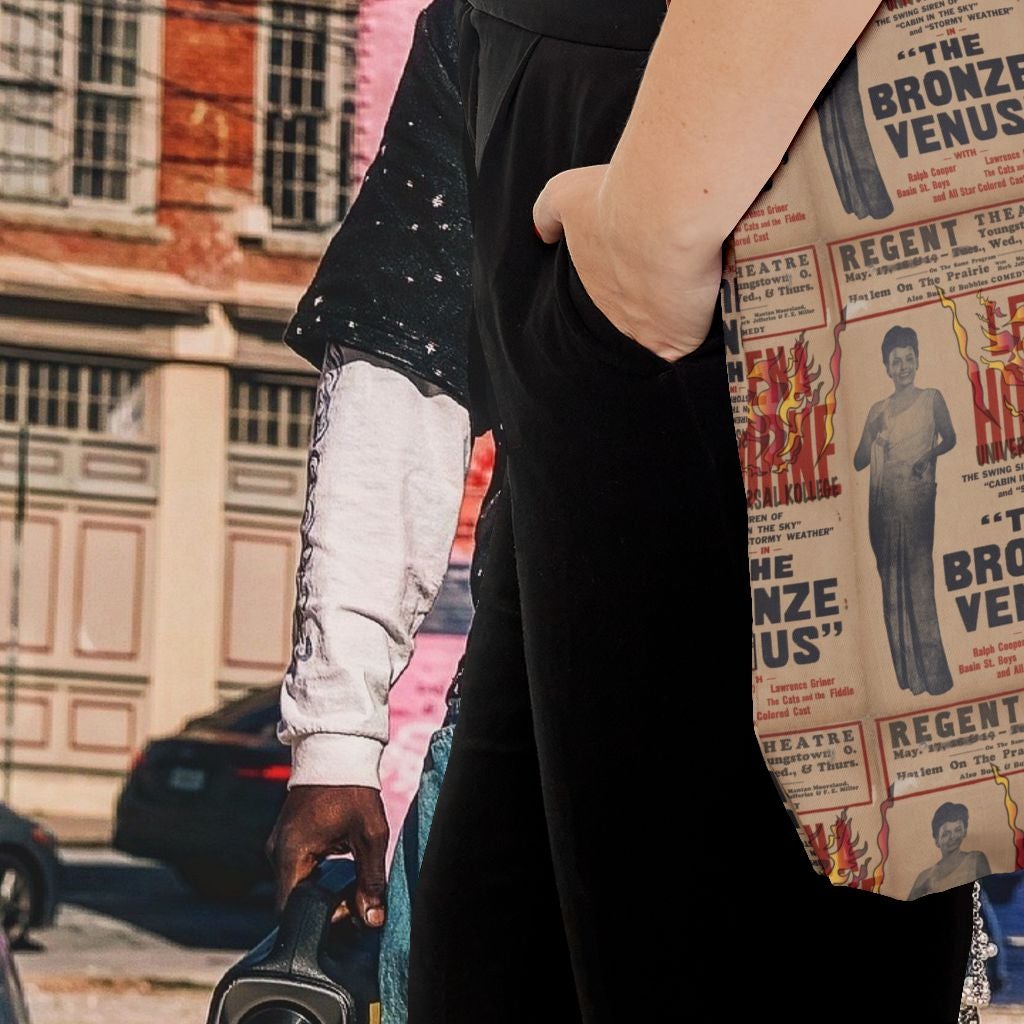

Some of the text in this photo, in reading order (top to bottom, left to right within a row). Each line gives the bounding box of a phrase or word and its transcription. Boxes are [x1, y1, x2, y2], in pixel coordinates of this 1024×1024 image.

[892, 7, 920, 21] SWING
[920, 0, 945, 13] SIREN
[925, 12, 935, 21] IN
[937, 7, 955, 18] THE
[908, 26, 923, 37] and
[945, 27, 956, 36] IN
[953, 147, 977, 160] WITH
[984, 150, 1021, 165] Lawrence
[906, 164, 956, 182] Ralph Cooper
[982, 169, 996, 178] The
[996, 164, 1016, 176] Cats
[918, 182, 931, 193] St.
[931, 179, 951, 190] Boys
[932, 191, 947, 203] and
[948, 188, 959, 199] All
[958, 186, 976, 197] Star
[976, 177, 1008, 193] Colored
[838, 219, 957, 271] REGENT
[844, 267, 872, 283] May.
[896, 282, 914, 293] On
[917, 276, 941, 288] The
[946, 264, 990, 281] Prairie
[961, 471, 979, 483] THE
[981, 464, 1012, 479] SWING
[997, 487, 1013, 498] and
[770, 511, 782, 521] OF
[757, 523, 775, 533] THE
[760, 545, 770, 555] IN
[972, 638, 1024, 658] Ralph Cooper
[983, 658, 995, 669] St.
[997, 654, 1017, 665] Boys
[996, 666, 1011, 679] and
[1013, 663, 1024, 675] All
[888, 695, 1019, 749] REGENT
[949, 759, 967, 770] On
[972, 753, 996, 765] The
